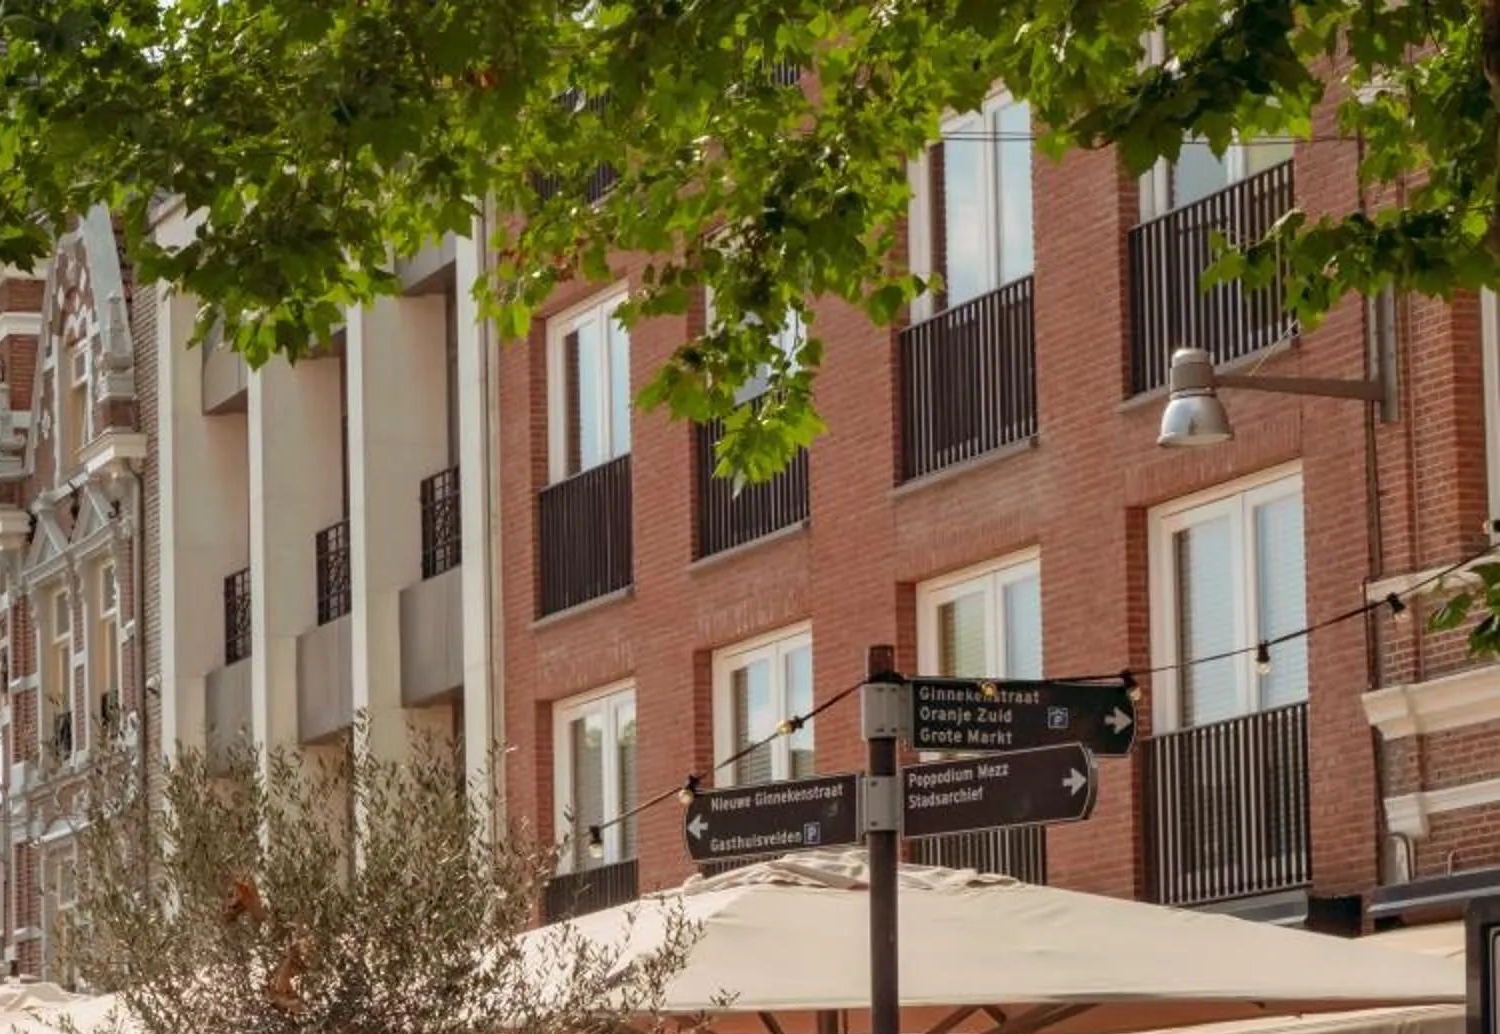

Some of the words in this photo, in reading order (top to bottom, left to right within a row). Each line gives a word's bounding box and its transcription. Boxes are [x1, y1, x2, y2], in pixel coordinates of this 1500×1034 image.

[919, 707, 971, 725] Oranje
[977, 707, 1013, 722] Zuid
[919, 728, 963, 743] Grote
[967, 730, 1013, 745] Markt
[909, 769, 973, 788] Poppodium
[711, 796, 751, 812] Nieuwe
[755, 783, 843, 806] Ginnekenstraat
[908, 786, 983, 809] Stadsarchief
[711, 831, 801, 851] Gasthuisvelden
